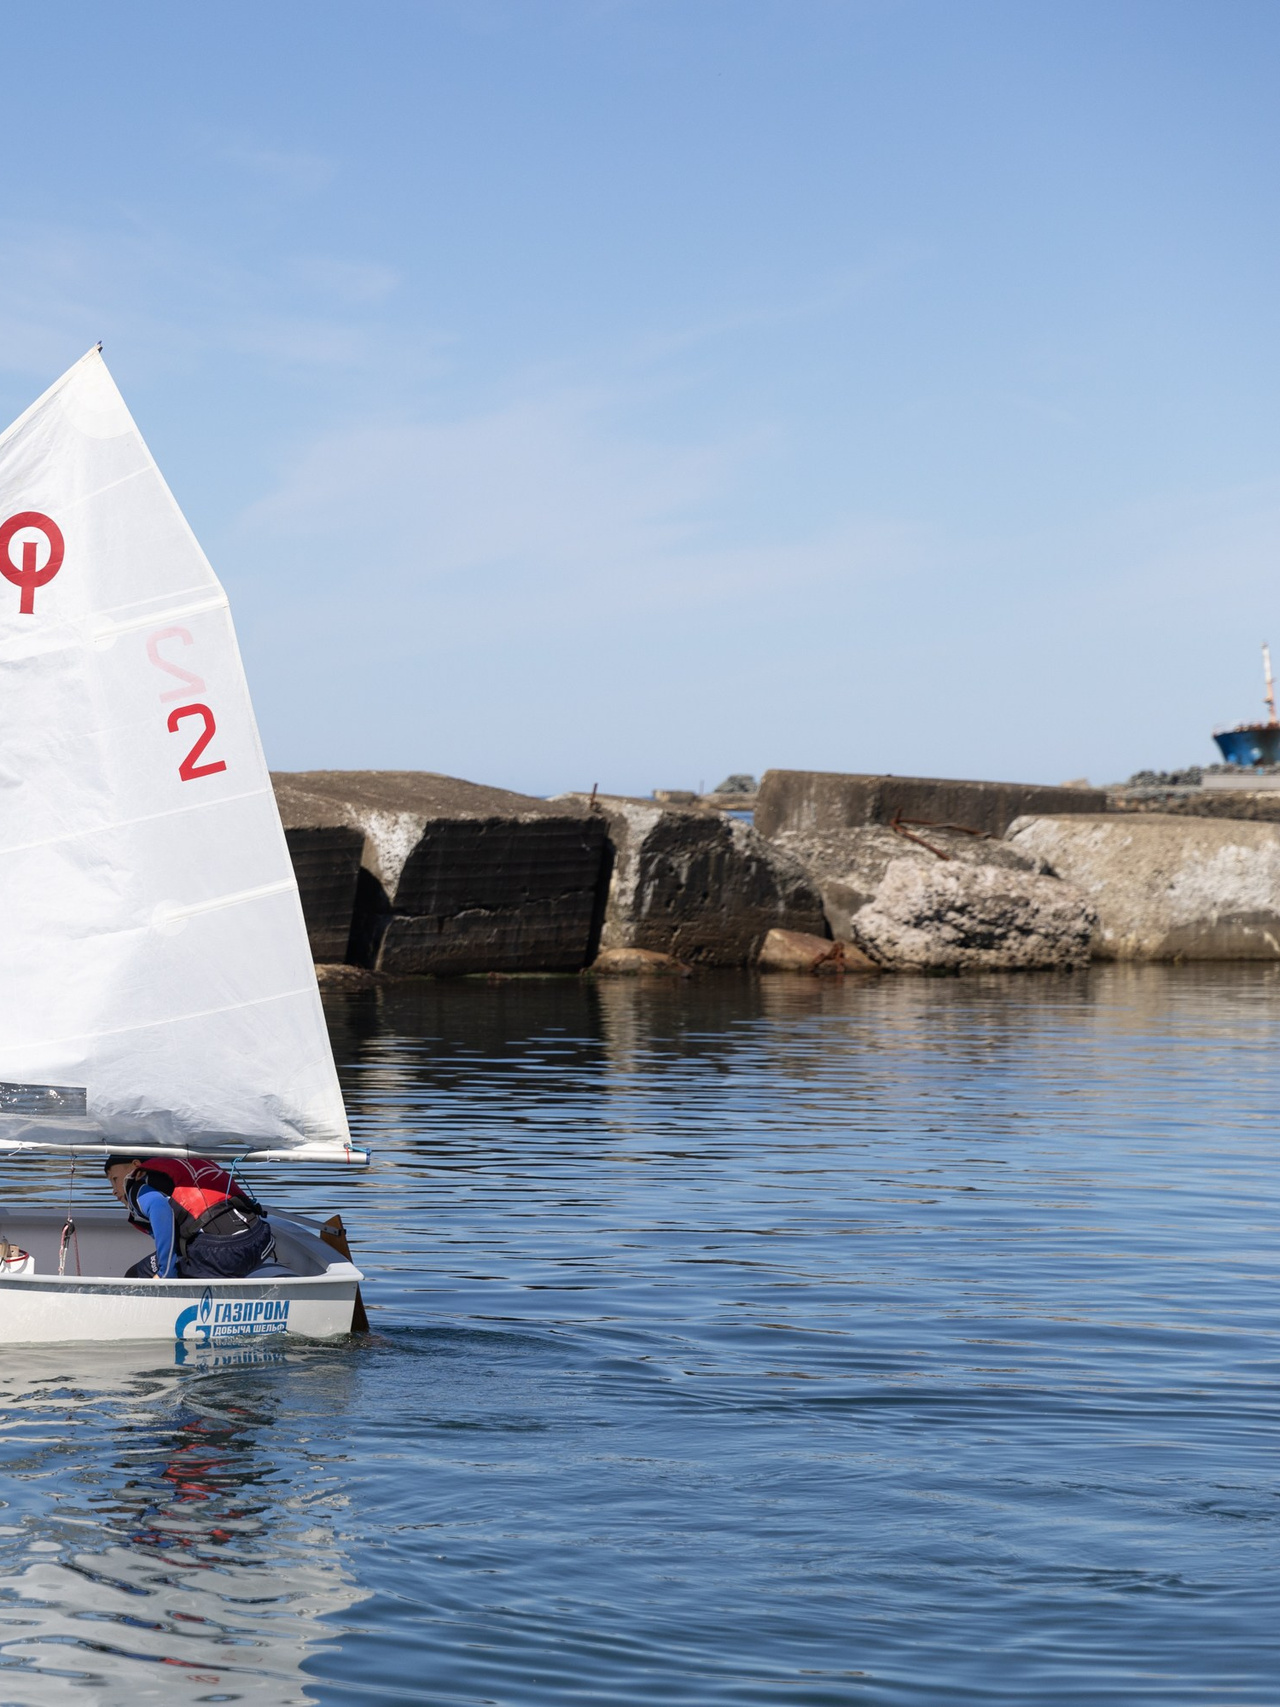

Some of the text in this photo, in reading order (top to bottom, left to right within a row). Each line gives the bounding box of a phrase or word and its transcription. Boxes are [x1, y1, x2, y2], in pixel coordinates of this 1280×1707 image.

[167, 703, 227, 782] 2
[214, 1300, 290, 1323] ГАЗПРОМ
[215, 1325, 251, 1336] ДОБЫЧА
